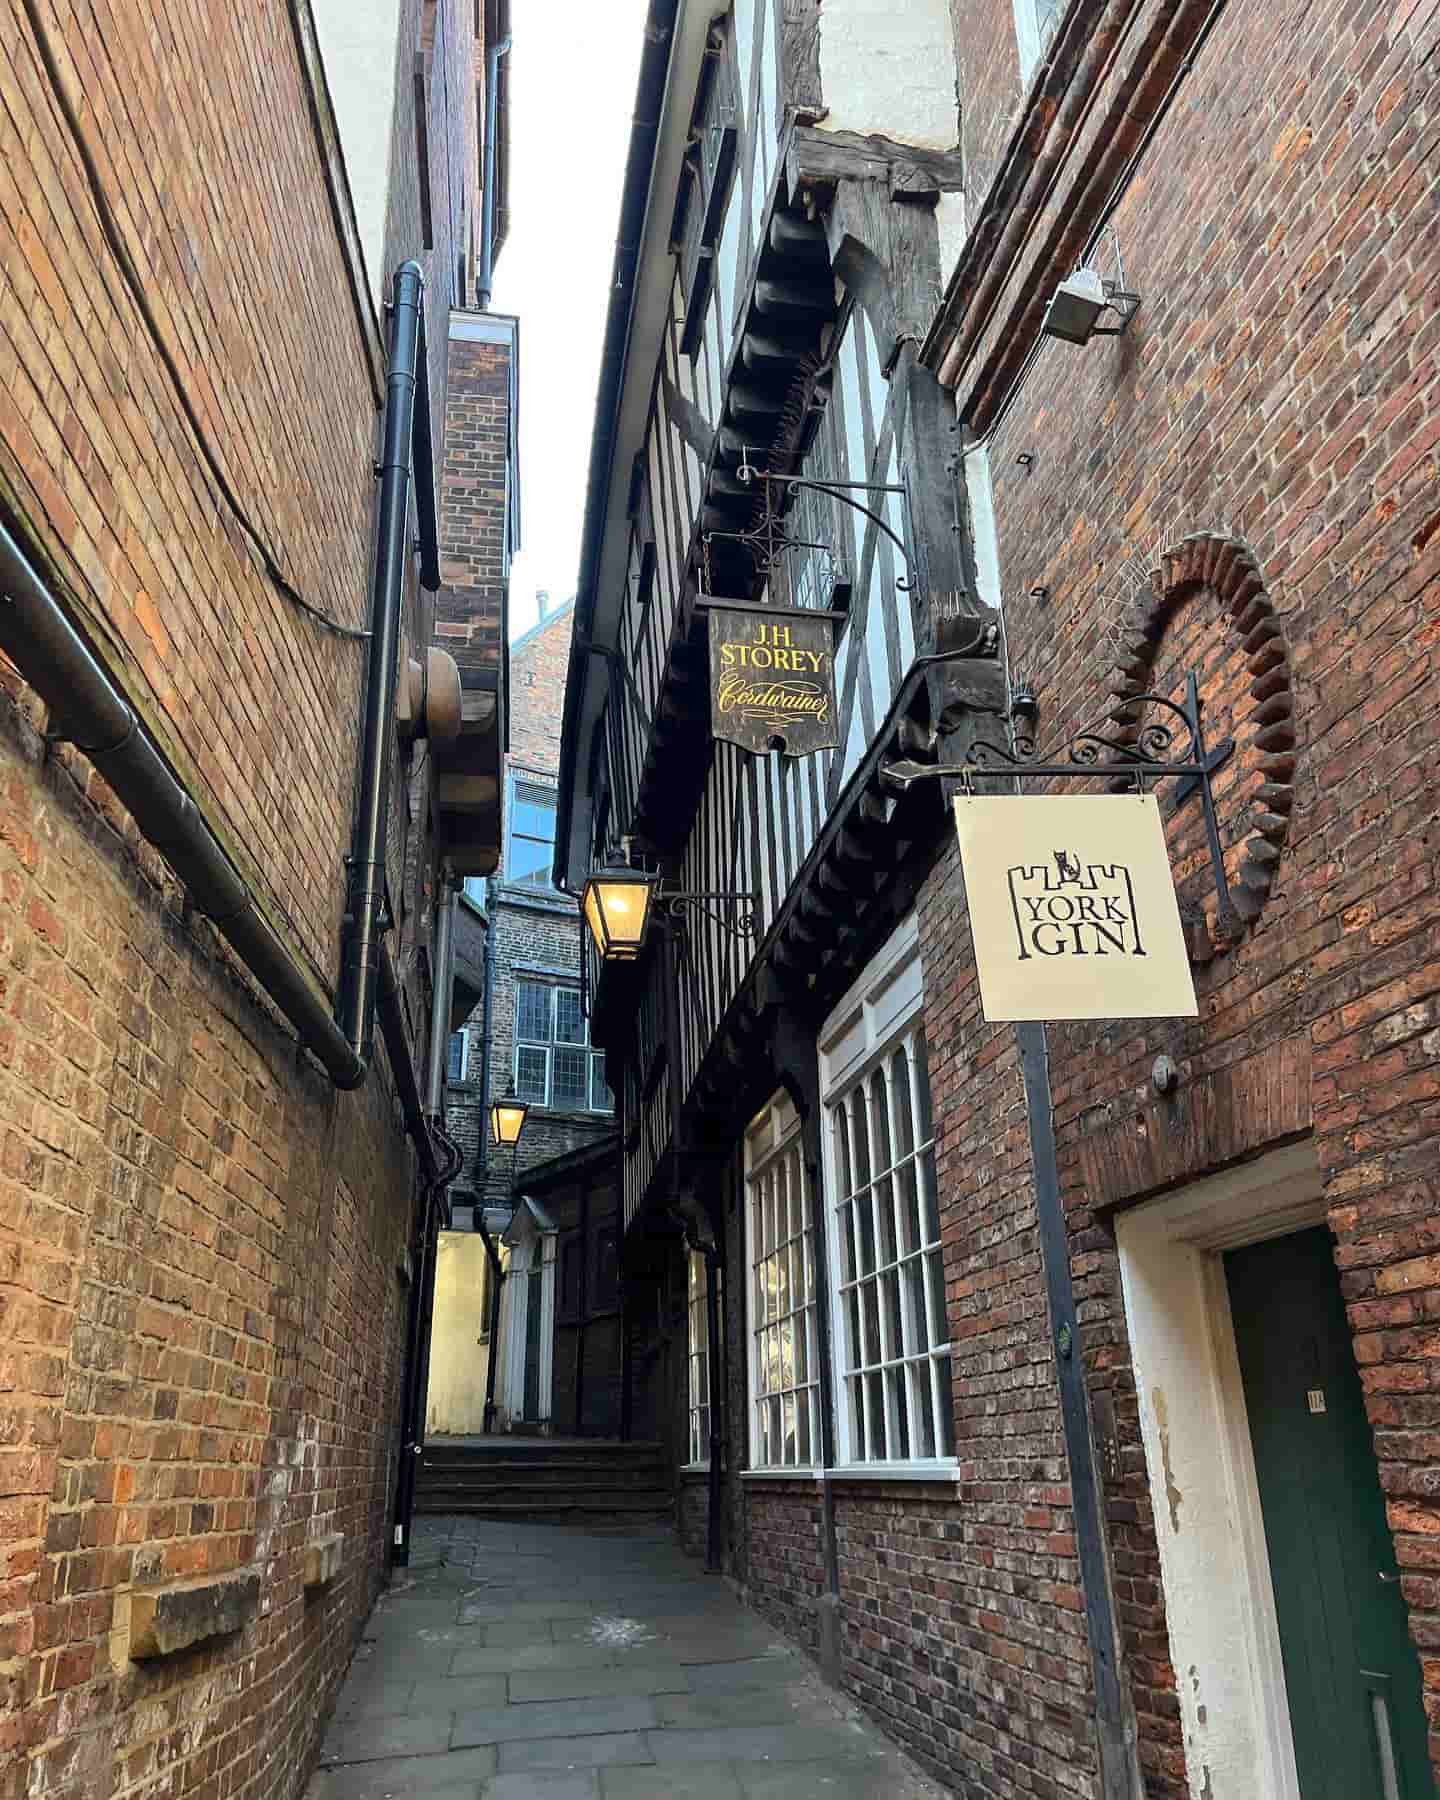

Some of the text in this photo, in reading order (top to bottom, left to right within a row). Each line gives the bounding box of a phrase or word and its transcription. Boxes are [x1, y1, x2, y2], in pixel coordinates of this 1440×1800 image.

[720, 643, 824, 672] STOREY
[719, 668, 828, 724] Cordwainer
[1021, 896, 1128, 921] YORK
[1031, 921, 1126, 956] GIN
